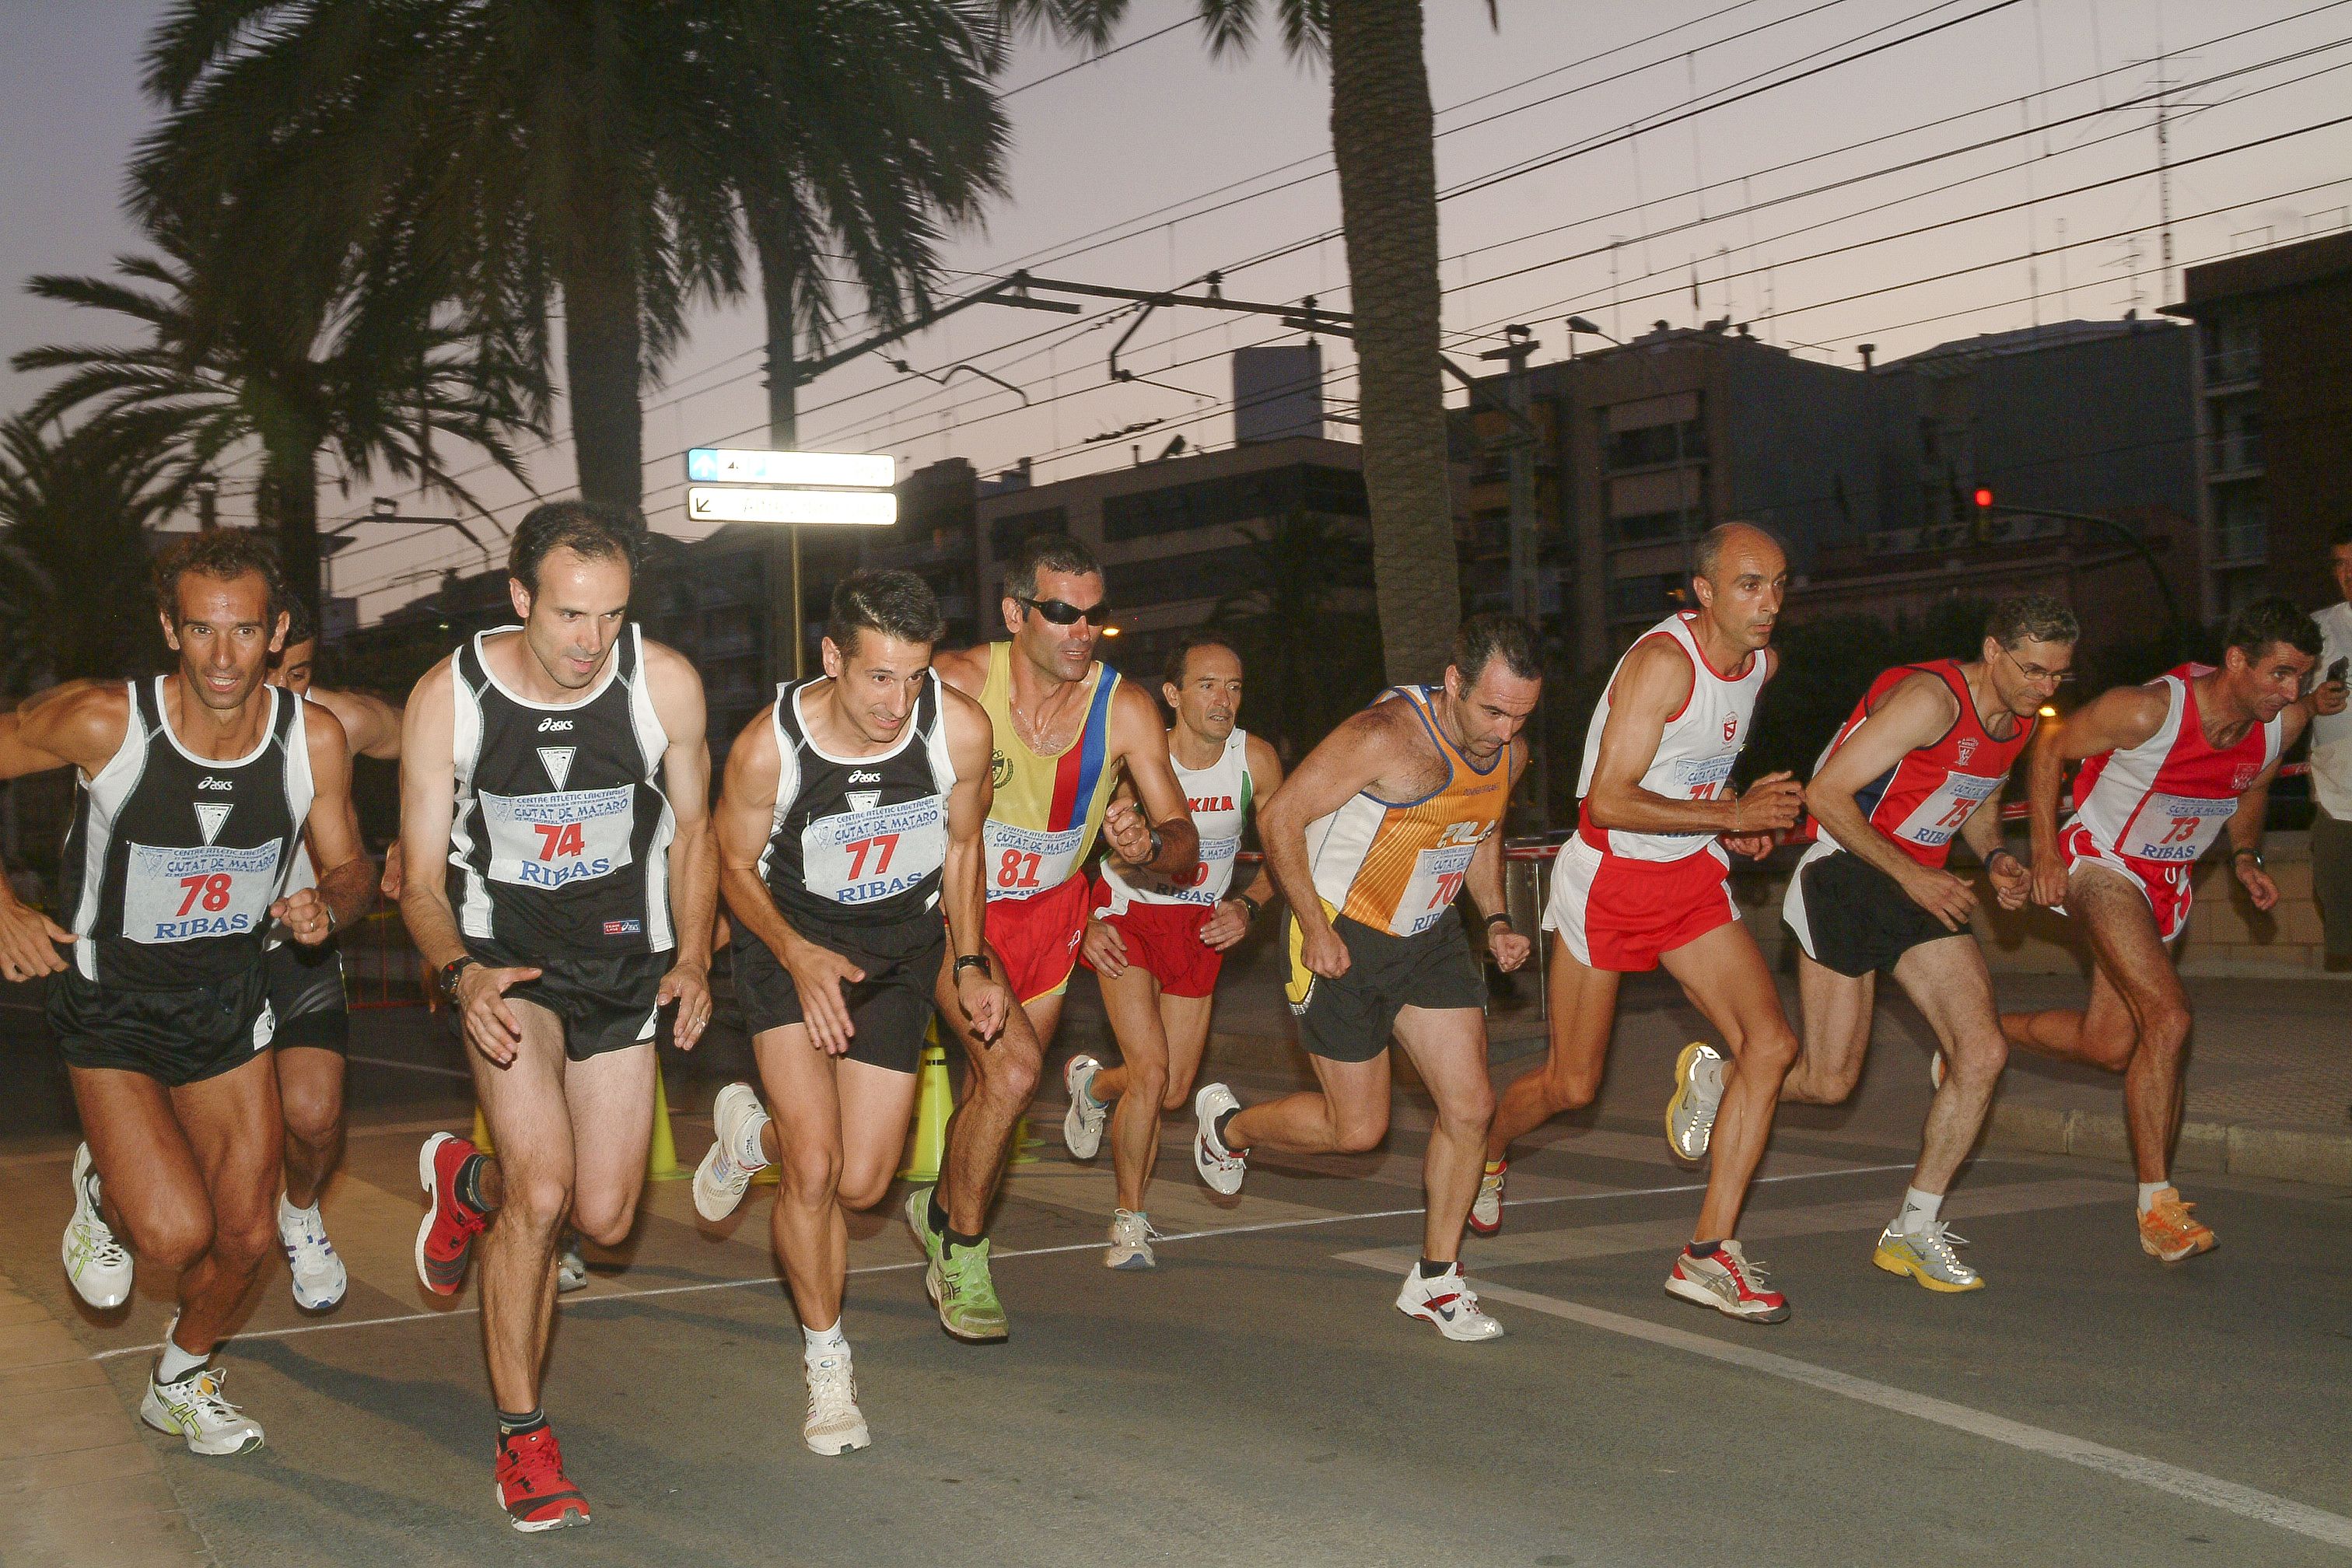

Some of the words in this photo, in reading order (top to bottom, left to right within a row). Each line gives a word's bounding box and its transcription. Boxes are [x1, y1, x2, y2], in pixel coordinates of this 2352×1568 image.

[514, 808, 554, 820] CIUTAT
[559, 807, 574, 819] DE
[578, 798, 628, 817] MATARO
[837, 812, 865, 824] CENTRE
[1936, 797, 1977, 828] 75
[835, 822, 870, 840] CIUTAT
[874, 821, 887, 831] DE
[891, 810, 938, 828] MATARO
[2160, 817, 2200, 845] 73
[534, 822, 585, 861] 74
[996, 831, 1028, 846] CIUTAT
[1030, 841, 1041, 851] DE
[2140, 844, 2196, 859] RIBAS
[167, 859, 207, 872] CIUTAT
[211, 857, 224, 868] DE
[228, 852, 276, 869] MATARO
[845, 834, 900, 880] 77
[996, 849, 1042, 888] 81
[519, 858, 610, 886] RIBAS
[175, 873, 232, 916] 78
[836, 872, 923, 902] RIBAS
[1427, 871, 1464, 910] 70
[154, 913, 249, 938] RIBAS
